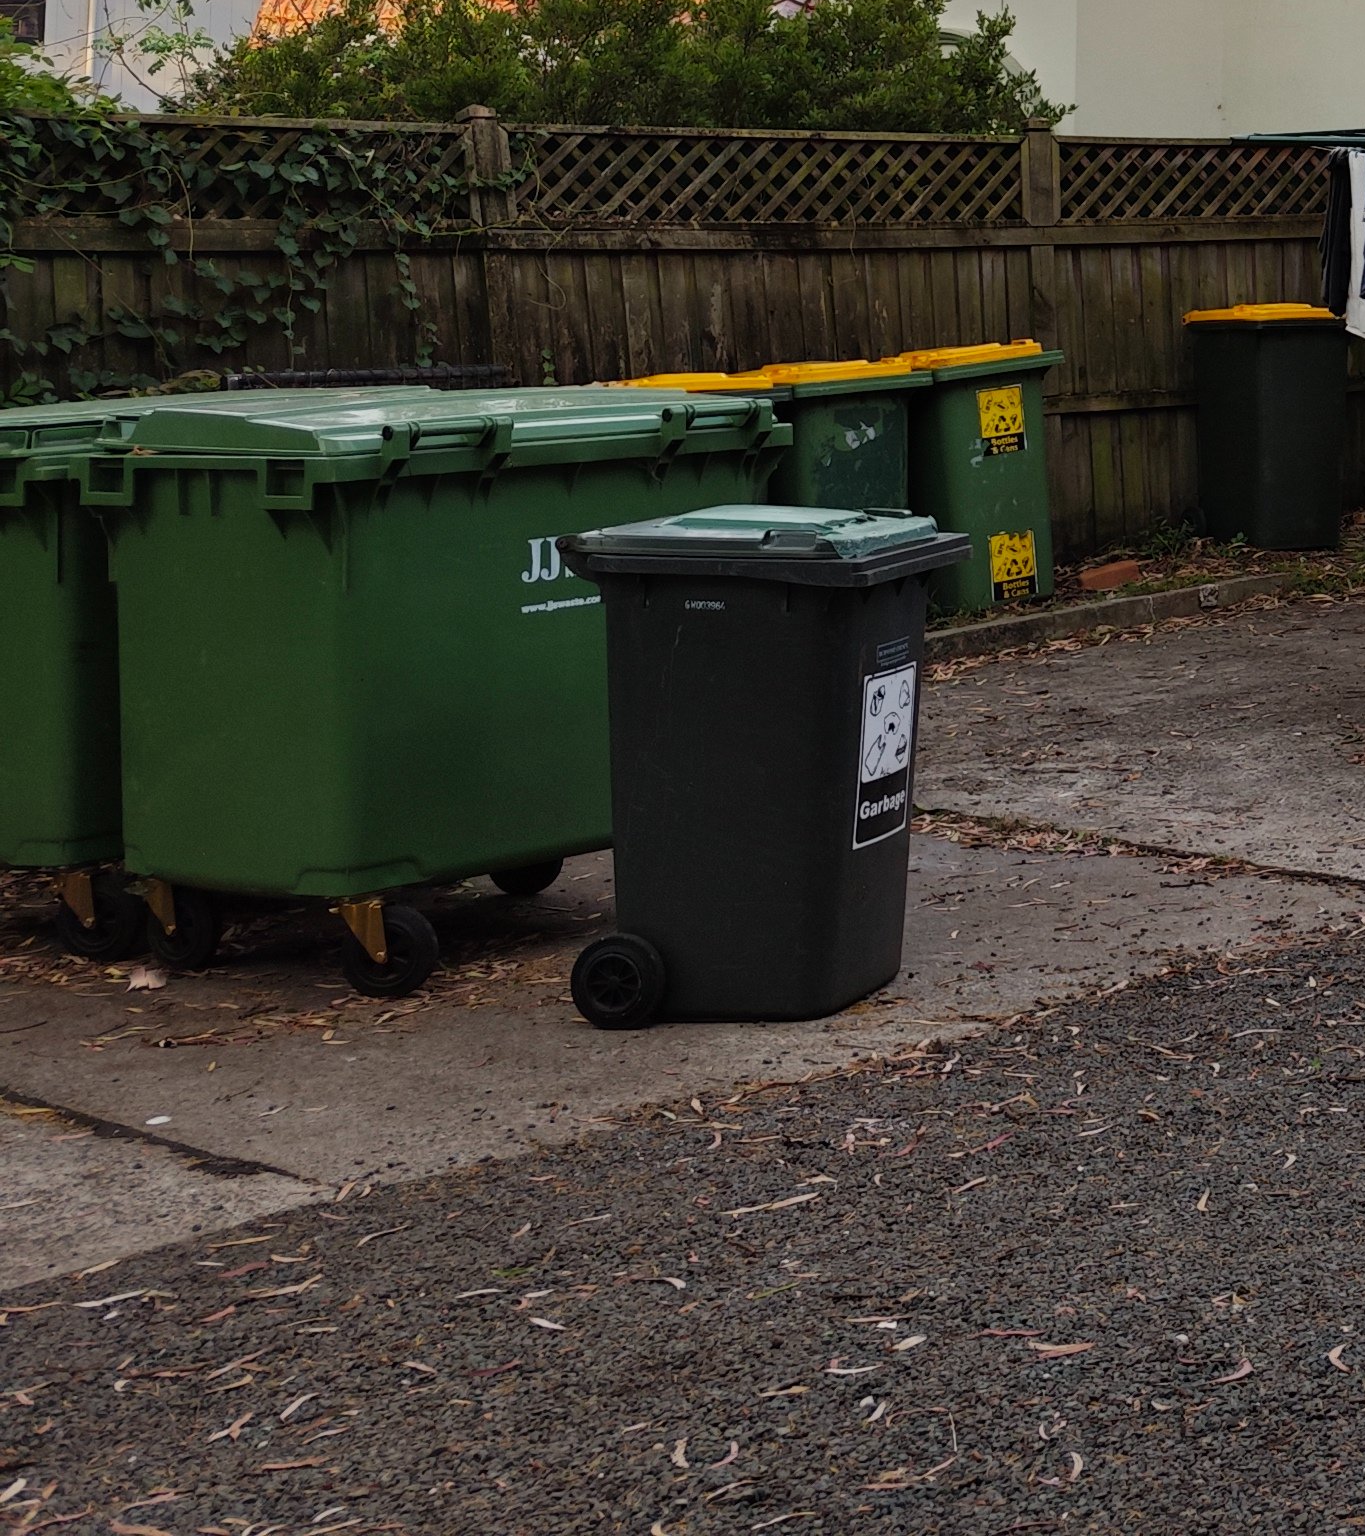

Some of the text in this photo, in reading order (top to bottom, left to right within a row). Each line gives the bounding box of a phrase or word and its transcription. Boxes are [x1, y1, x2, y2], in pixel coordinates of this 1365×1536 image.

[991, 436, 1018, 446] Bottles
[1002, 579, 1029, 591] Bottles
[859, 789, 906, 821] Garbage
